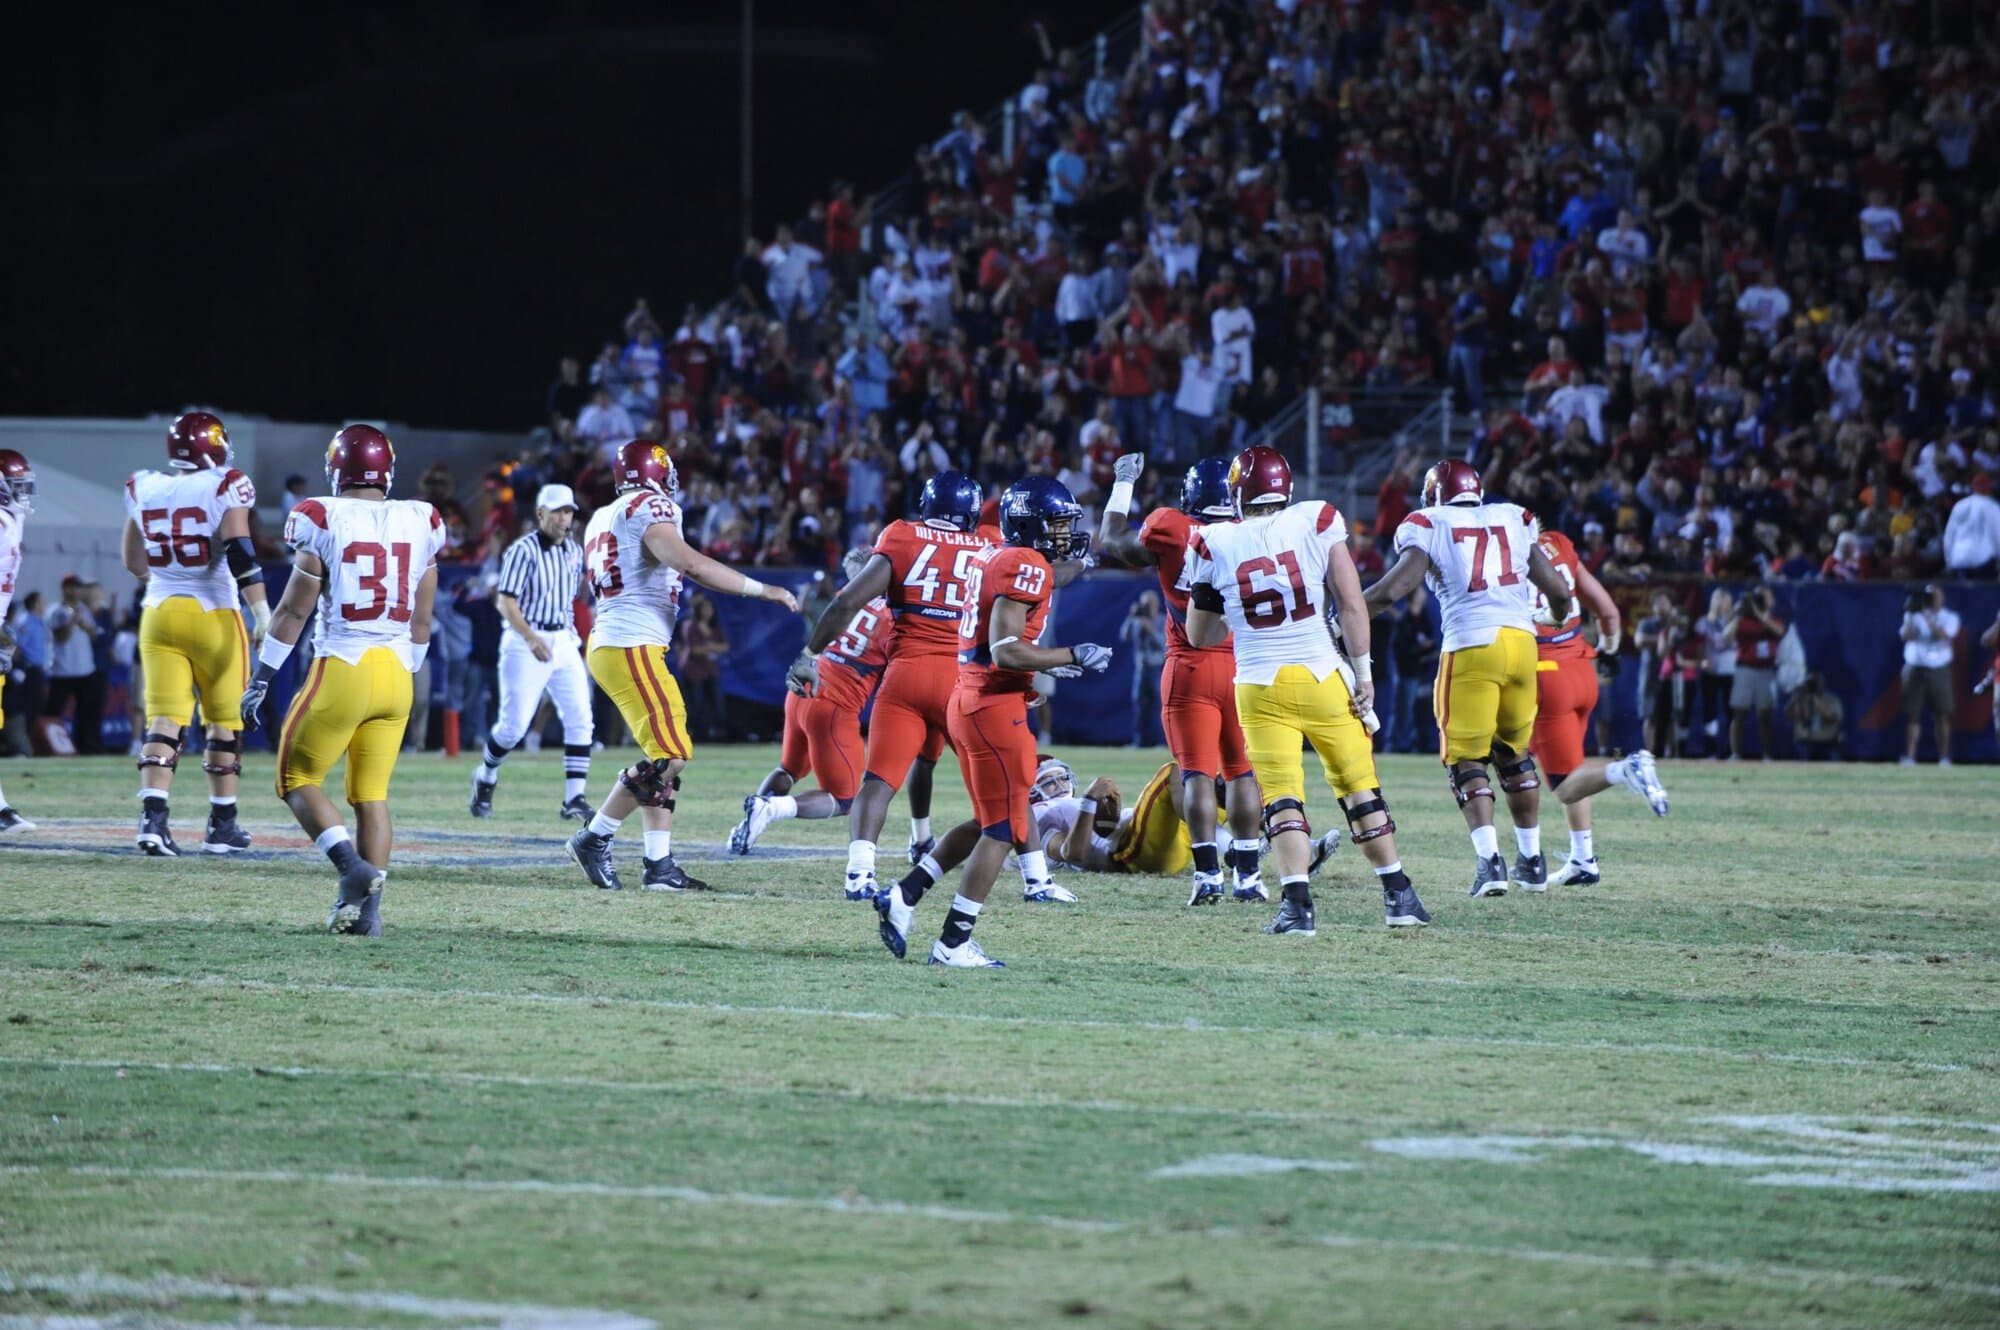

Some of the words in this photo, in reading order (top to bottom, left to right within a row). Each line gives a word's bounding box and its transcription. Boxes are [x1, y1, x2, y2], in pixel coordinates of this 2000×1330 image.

[648, 498, 675, 519] 53
[1009, 491, 1032, 516] A
[141, 507, 211, 567] 56
[1452, 525, 1519, 593] 71
[342, 541, 412, 622] 31
[1014, 563, 1046, 596] 23
[1235, 550, 1316, 630] 61
[921, 607, 957, 619] ARIZONA
